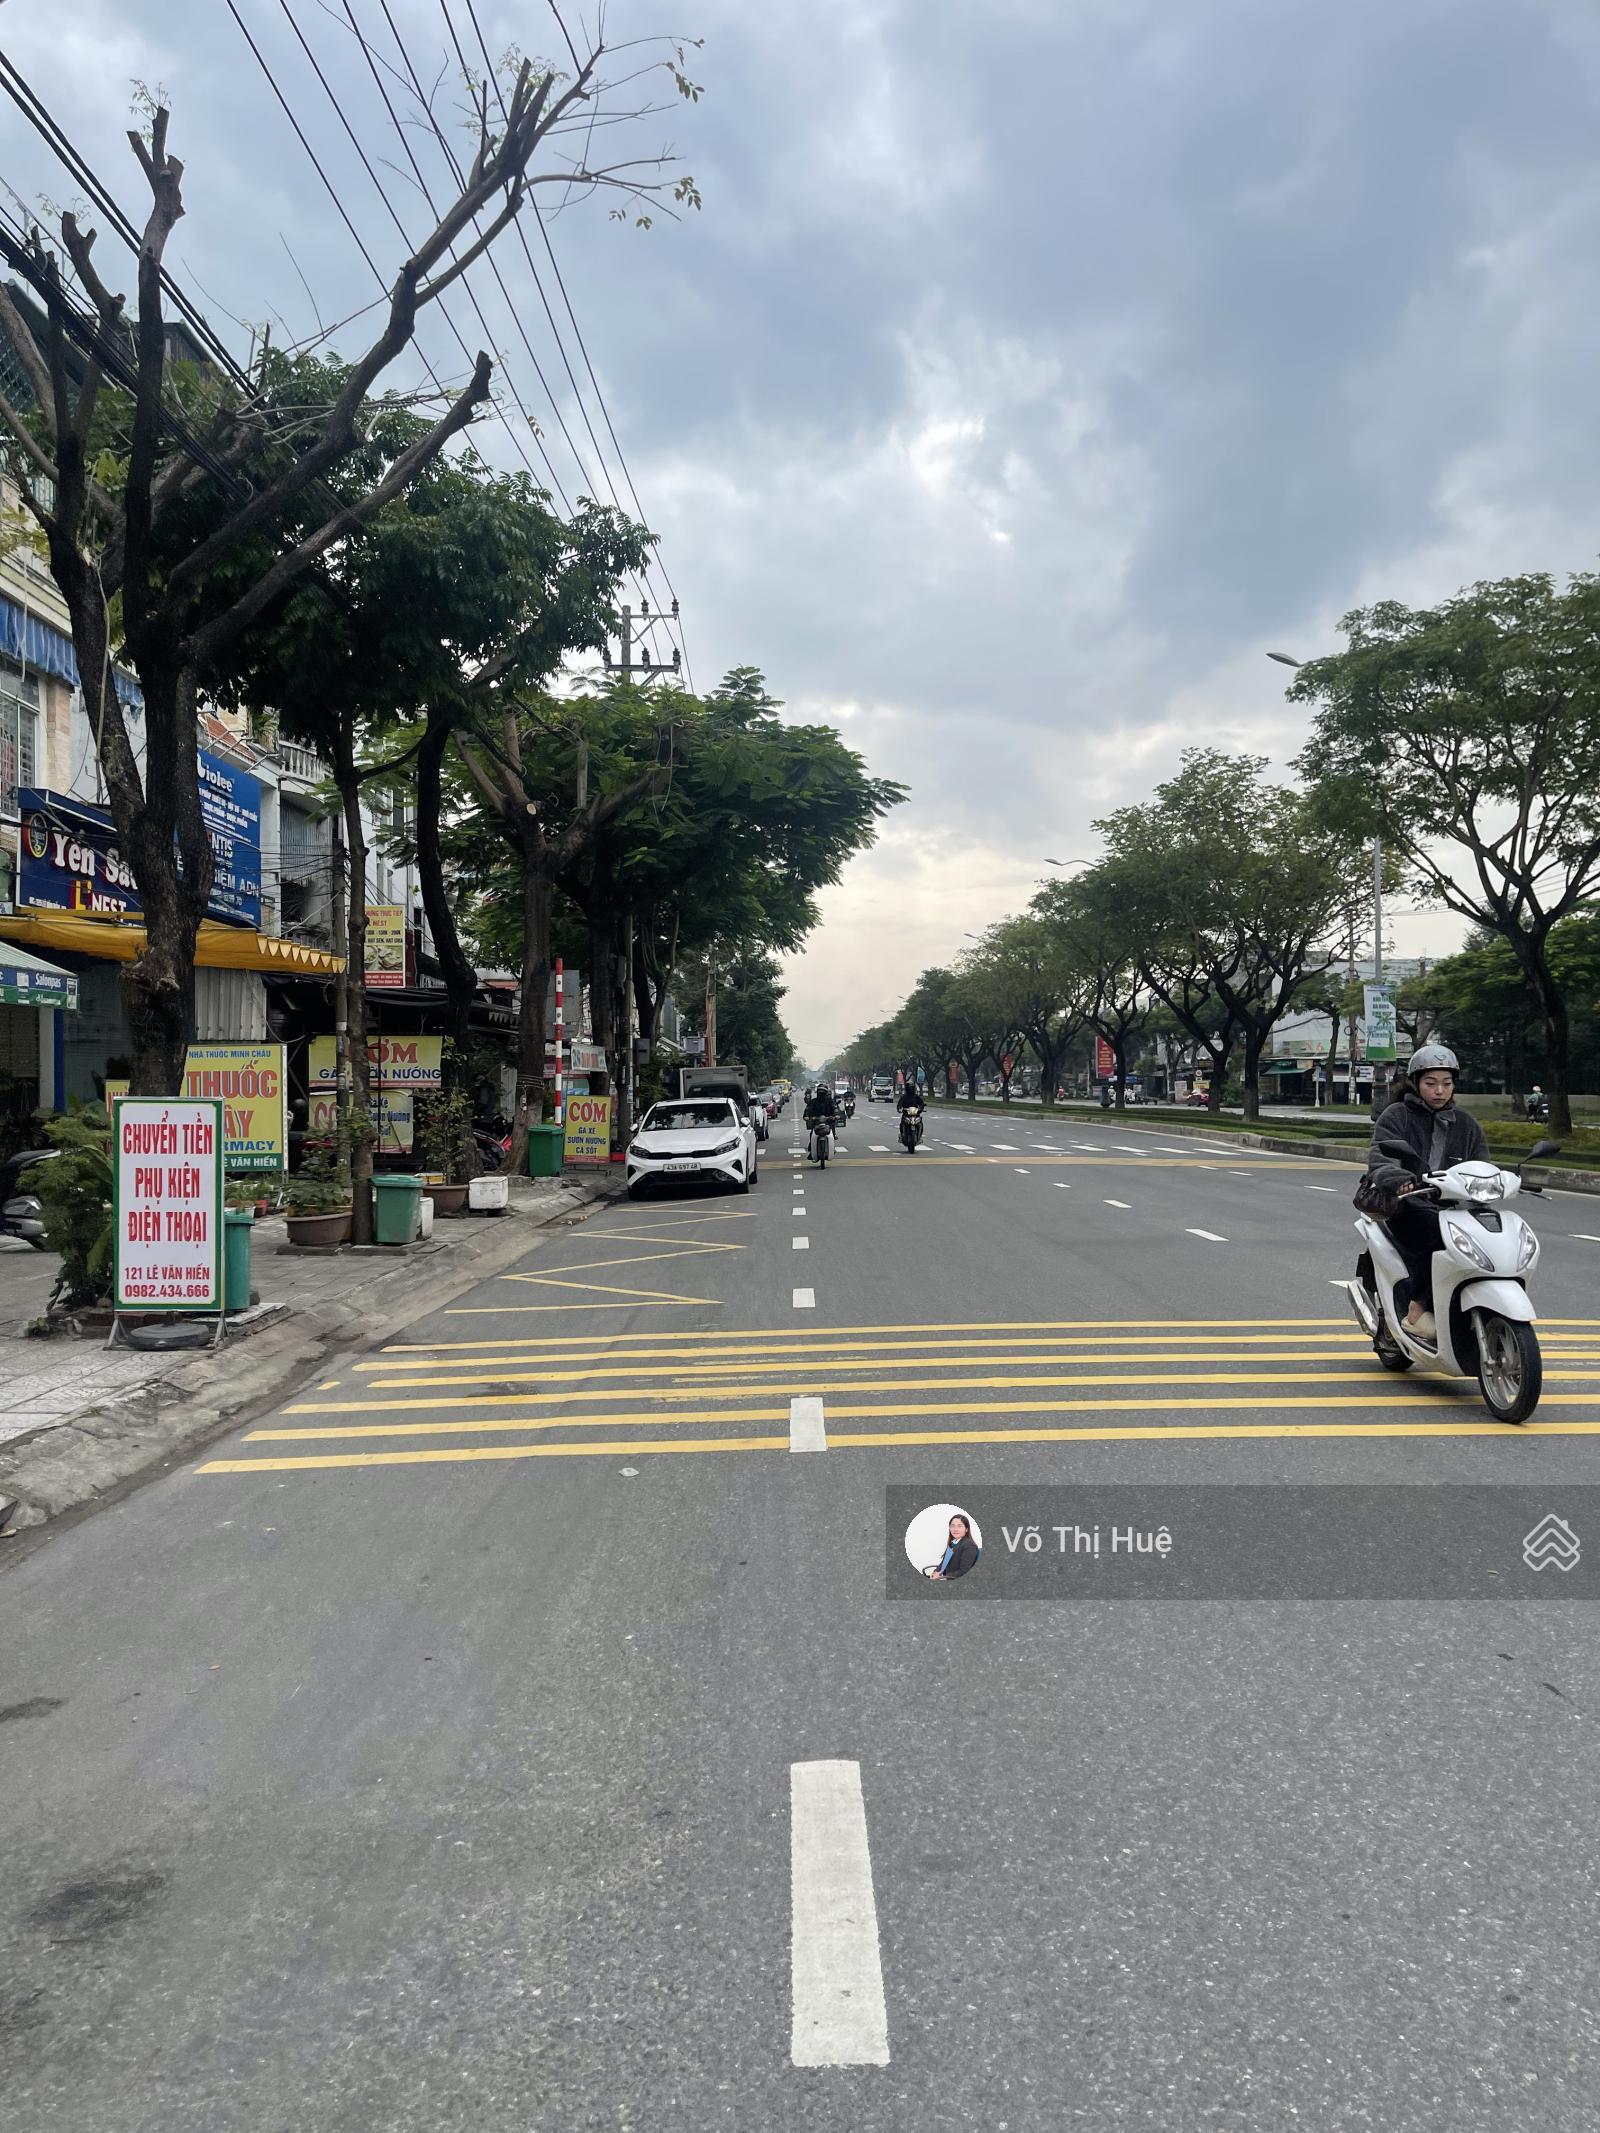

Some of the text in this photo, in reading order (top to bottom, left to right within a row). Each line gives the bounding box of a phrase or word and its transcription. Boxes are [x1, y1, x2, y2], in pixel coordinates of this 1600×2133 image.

[231, 1050, 250, 1058] MINH
[352, 1039, 417, 1064] ƠM
[186, 1060, 278, 1099] THUỐC
[392, 1066, 441, 1079] NƯỚNG
[224, 1104, 254, 1138] ÂY
[568, 1099, 607, 1123] CƠM
[123, 1110, 213, 1154] CHUYỂN TIỀN
[230, 1156, 250, 1167] VĂN
[254, 1155, 277, 1167] HIẾN
[135, 1161, 200, 1205] PHỤ KIỆN
[128, 1205, 206, 1248] ĐIỆN THOẠI
[125, 1262, 210, 1280] 121 LÊ VĂN HIẾN
[125, 1284, 210, 1298] 0982.434.666
